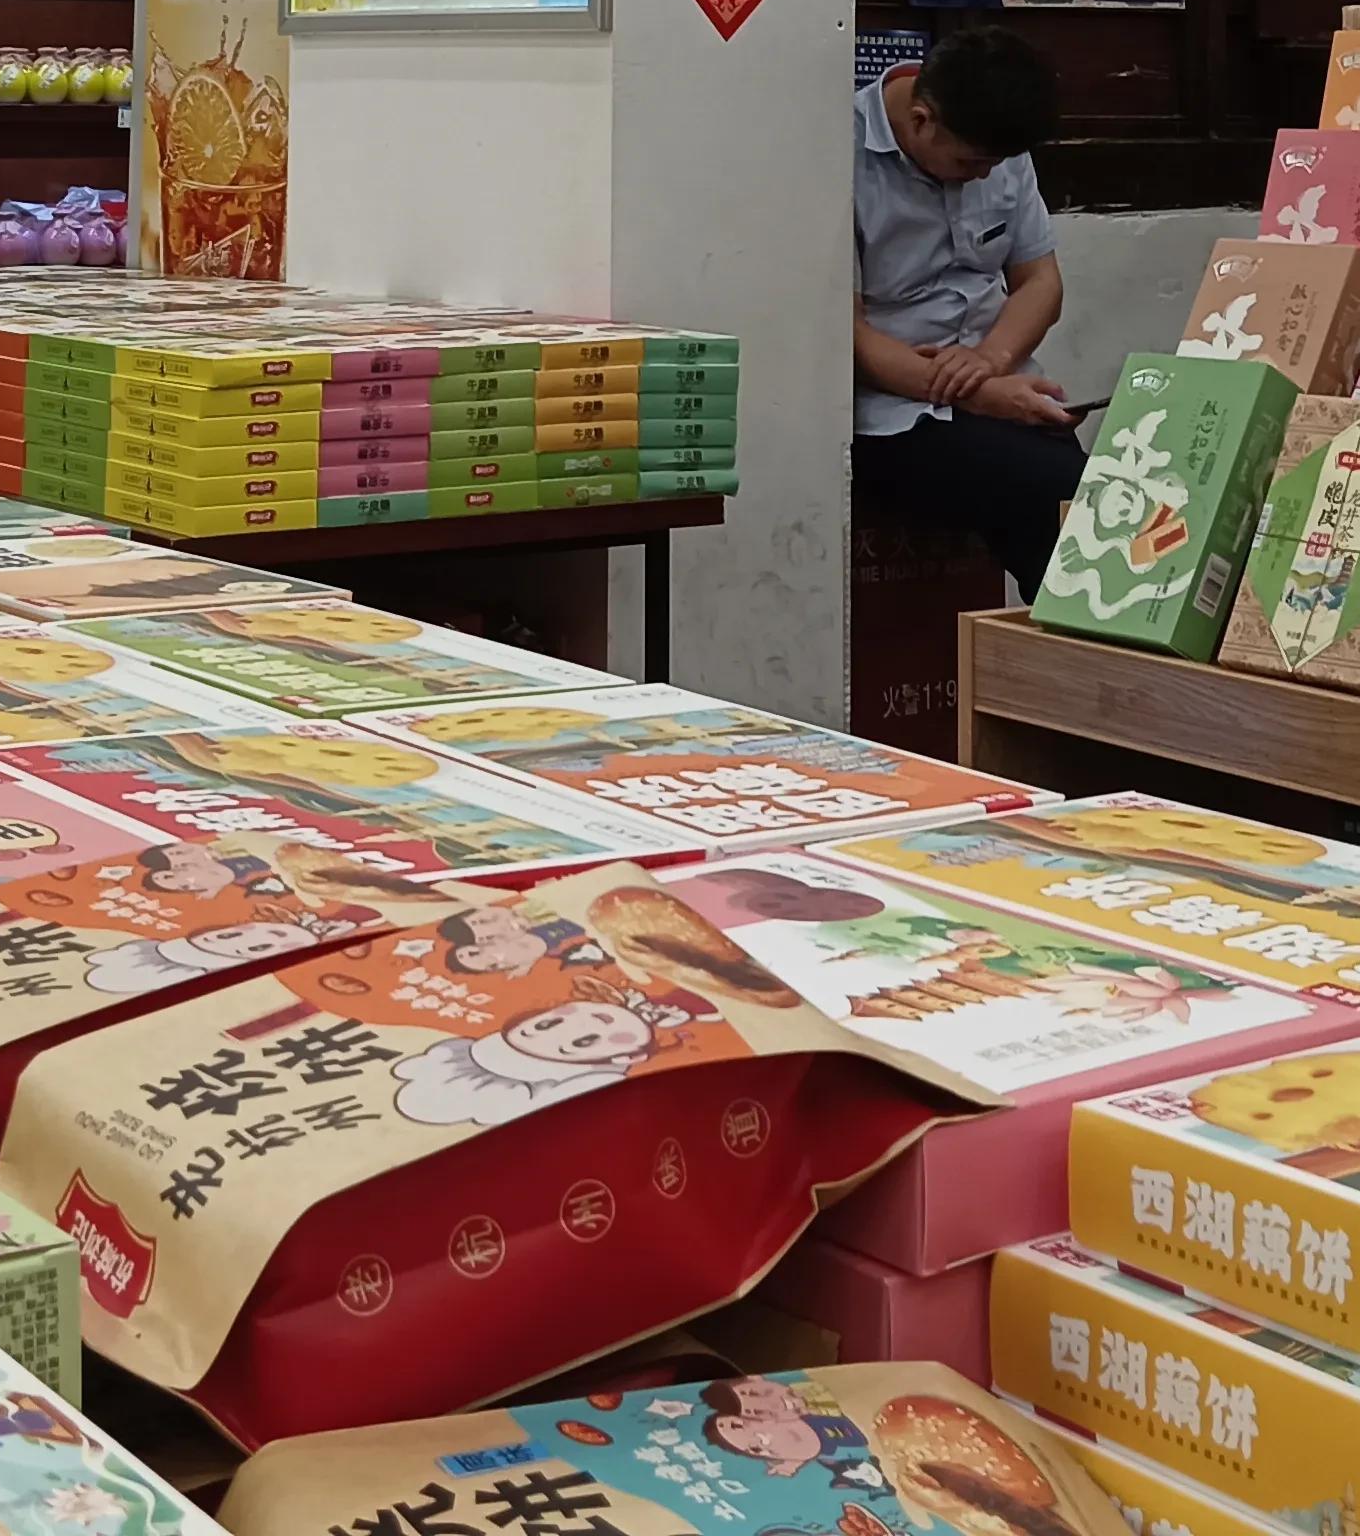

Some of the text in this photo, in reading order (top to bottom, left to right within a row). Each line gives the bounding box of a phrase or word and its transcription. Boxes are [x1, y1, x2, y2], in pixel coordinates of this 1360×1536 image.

[139, 1018, 403, 1120] 烧饼
[74, 1110, 163, 1164] LAO HANG ZHOU
[114, 1109, 177, 1144] SHAO BING
[160, 1095, 383, 1221] 老杭州
[71, 1203, 134, 1299] 杭城刘记
[1131, 1165, 1355, 1306] 西湖藕饼
[1049, 1313, 1260, 1461] 西湖藕饼
